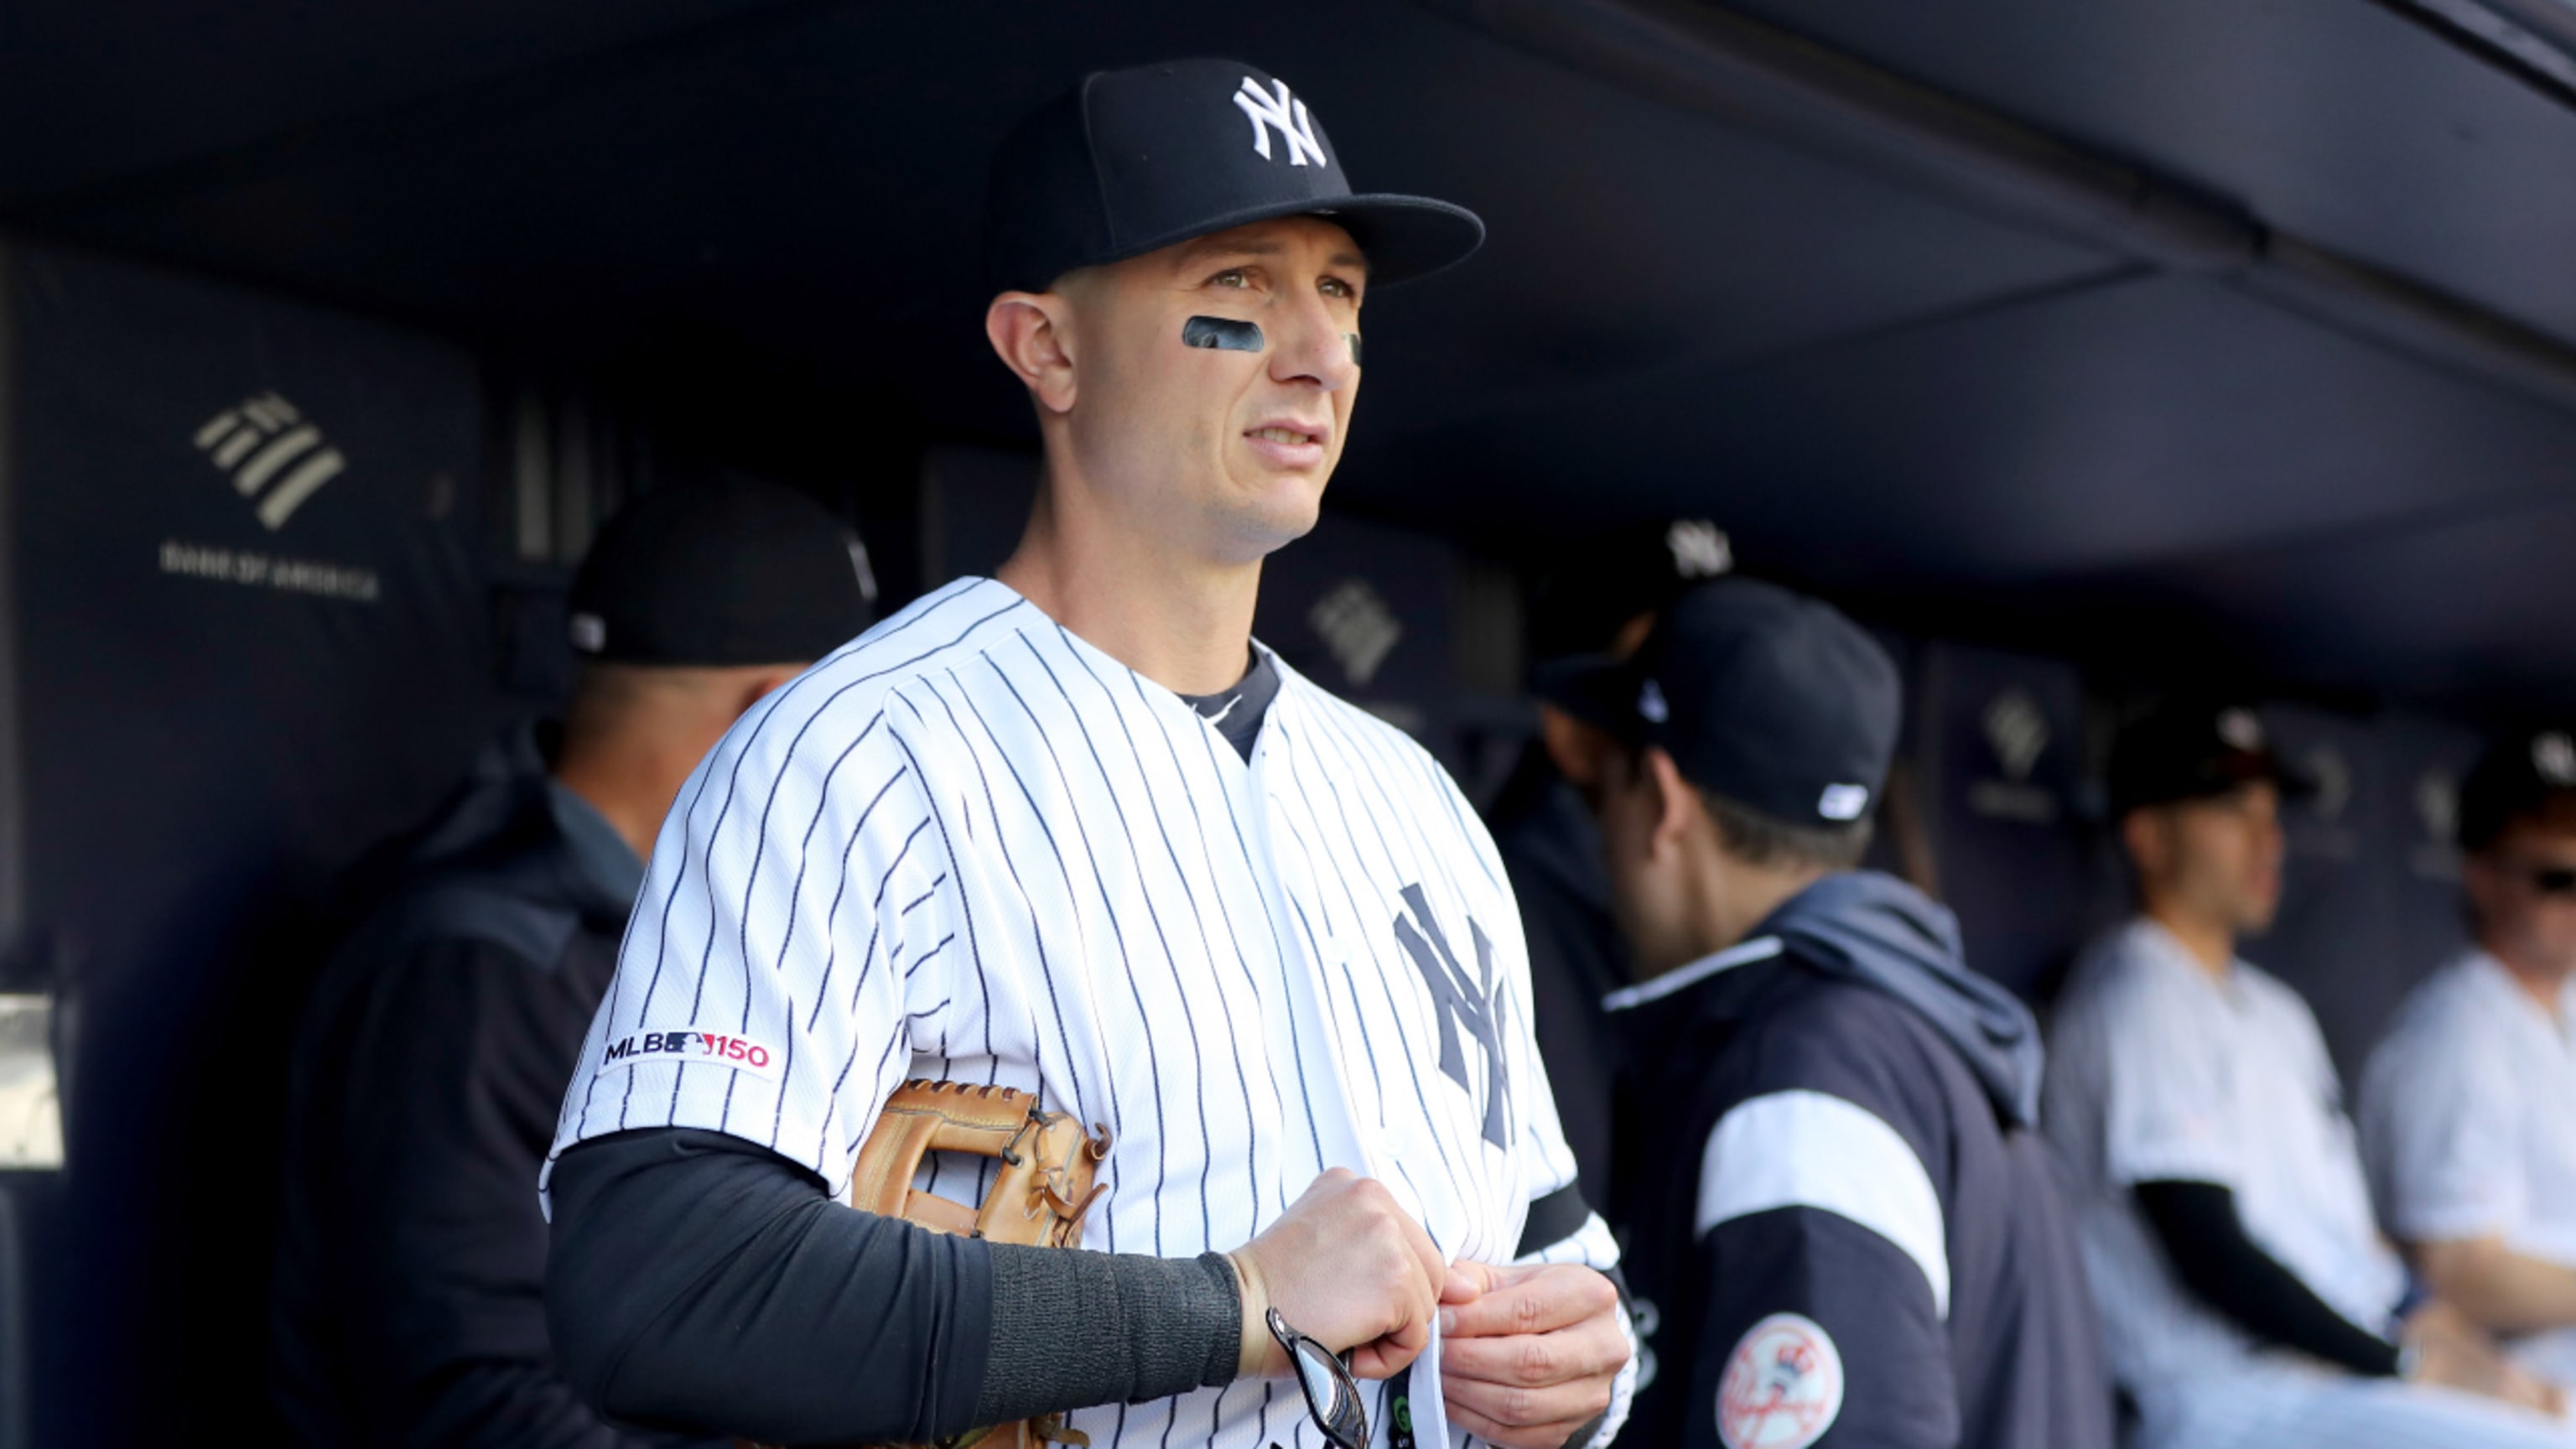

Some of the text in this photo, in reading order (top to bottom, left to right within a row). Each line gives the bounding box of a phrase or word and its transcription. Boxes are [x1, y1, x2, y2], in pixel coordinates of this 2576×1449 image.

[1233, 75, 1327, 169] NY
[604, 1032, 770, 1068] MLB 150
[1392, 881, 1516, 1154] NY
